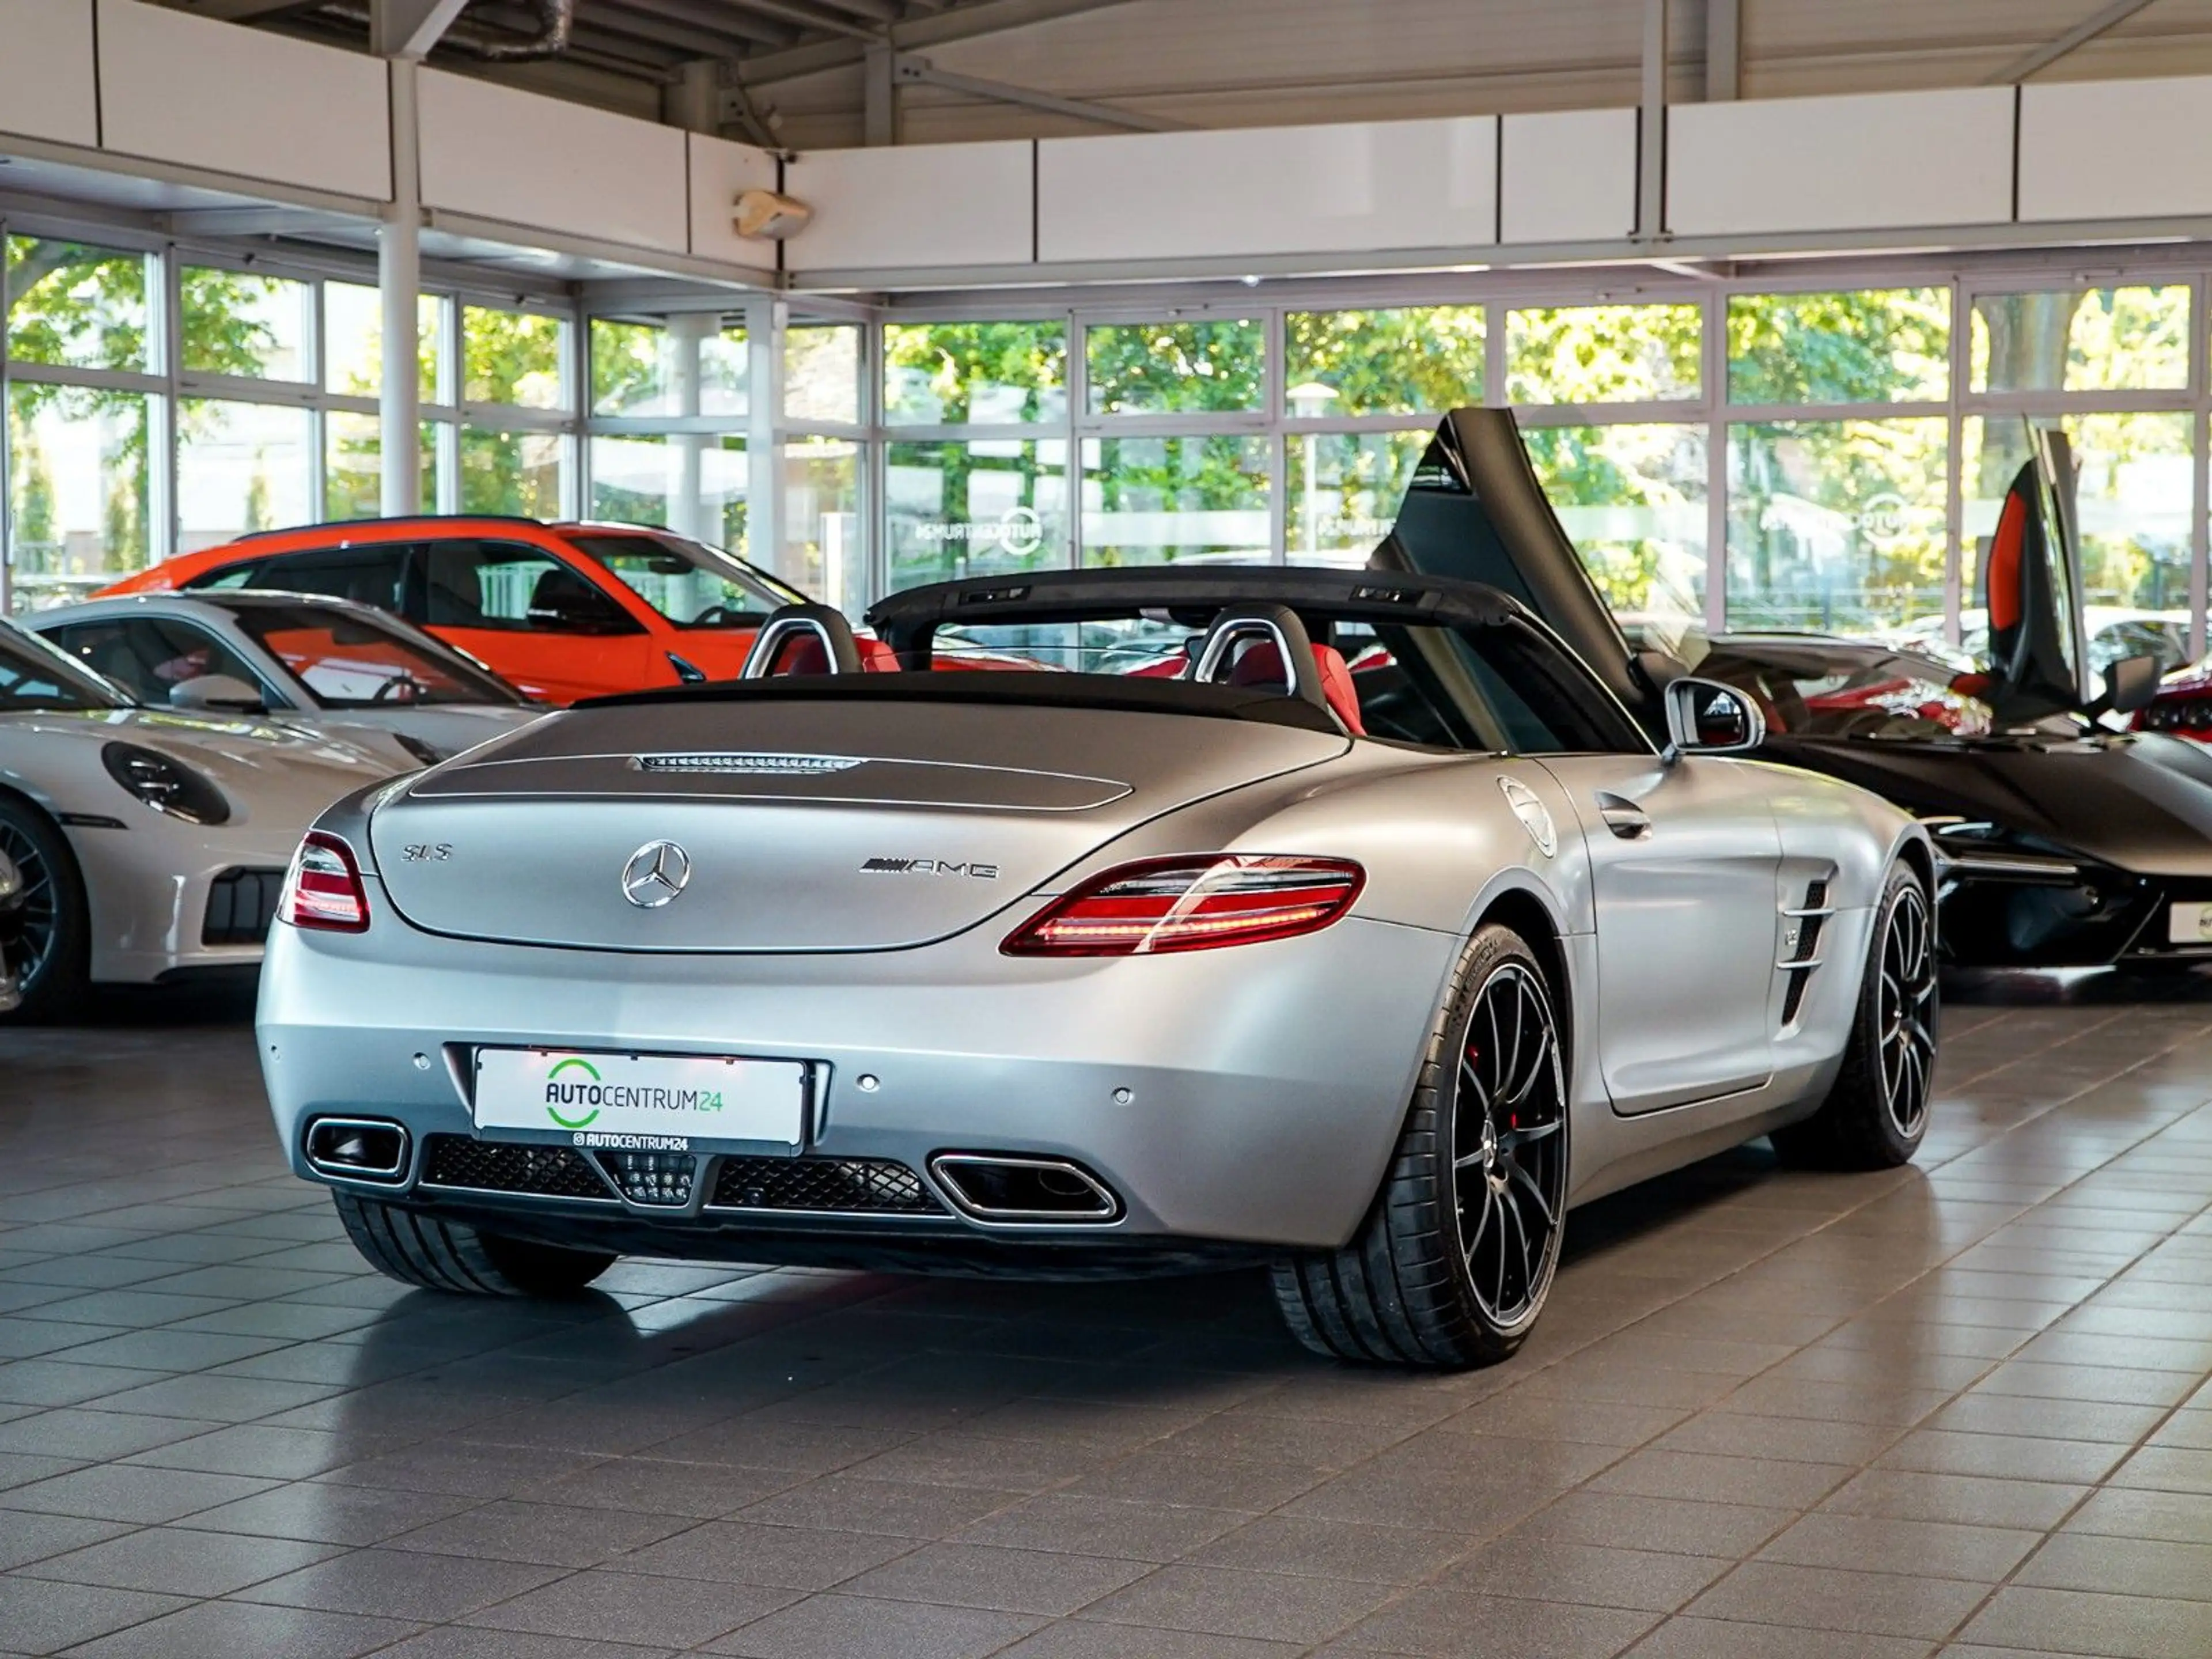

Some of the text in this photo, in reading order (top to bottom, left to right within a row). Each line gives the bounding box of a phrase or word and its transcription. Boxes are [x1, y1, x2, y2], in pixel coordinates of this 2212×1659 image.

[402, 844, 454, 862] SLS
[903, 859, 1001, 880] AMG
[547, 1083, 723, 1112] AUTOCENTRUM24
